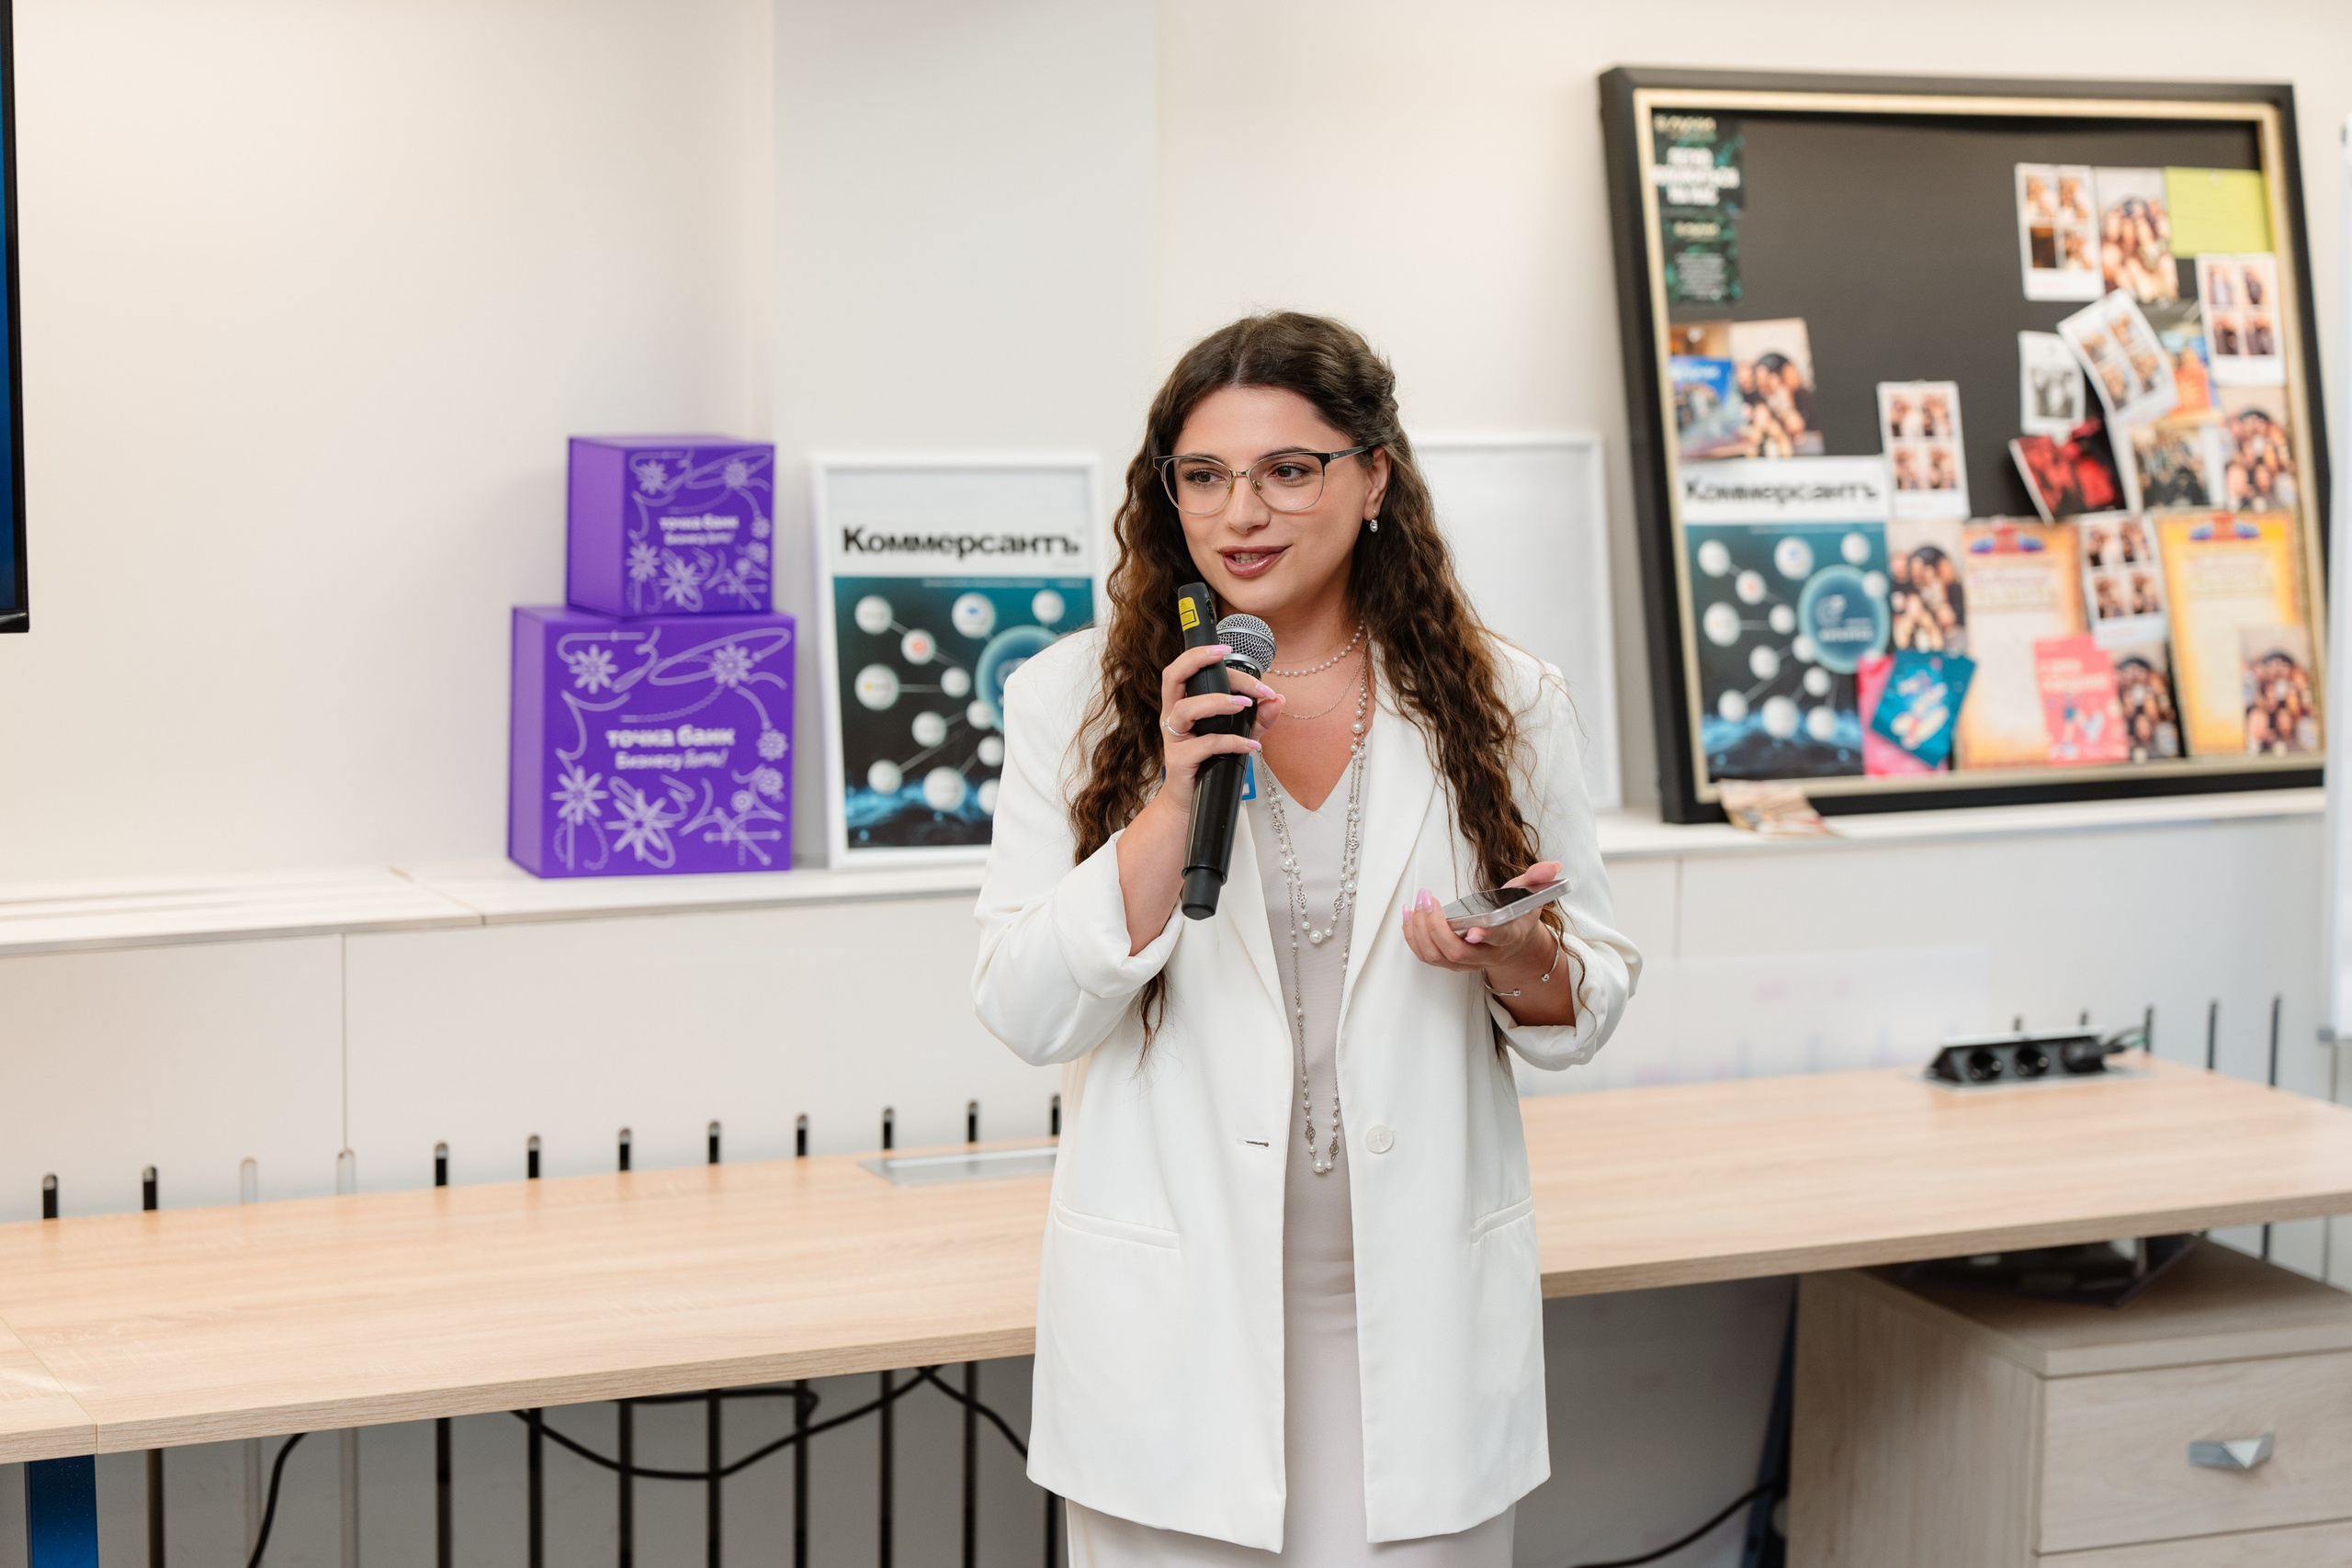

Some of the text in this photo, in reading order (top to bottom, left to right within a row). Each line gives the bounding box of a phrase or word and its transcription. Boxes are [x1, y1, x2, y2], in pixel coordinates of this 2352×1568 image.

[842, 526, 1080, 560] Коммерсантъ
[605, 724, 736, 748] точка банк
